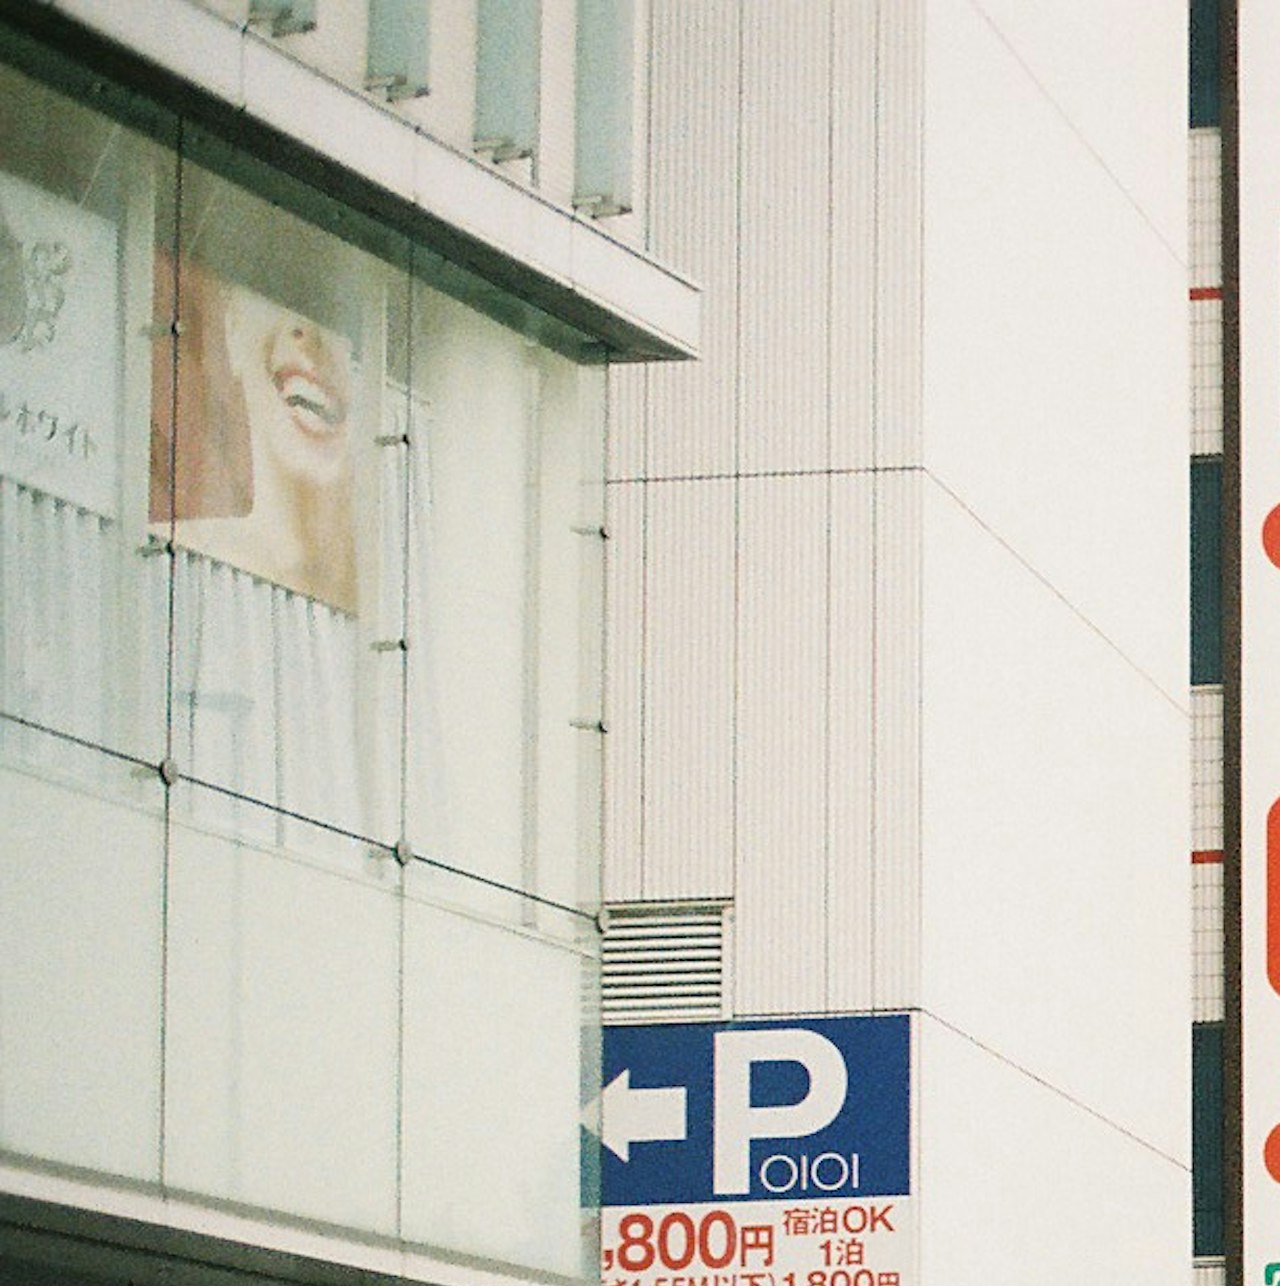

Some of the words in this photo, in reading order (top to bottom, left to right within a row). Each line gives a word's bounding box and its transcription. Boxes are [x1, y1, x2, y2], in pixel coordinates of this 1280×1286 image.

[713, 1028, 849, 1195] P
[783, 1204, 895, 1236] 宿泊OK
[819, 1238, 865, 1267] 1泊
